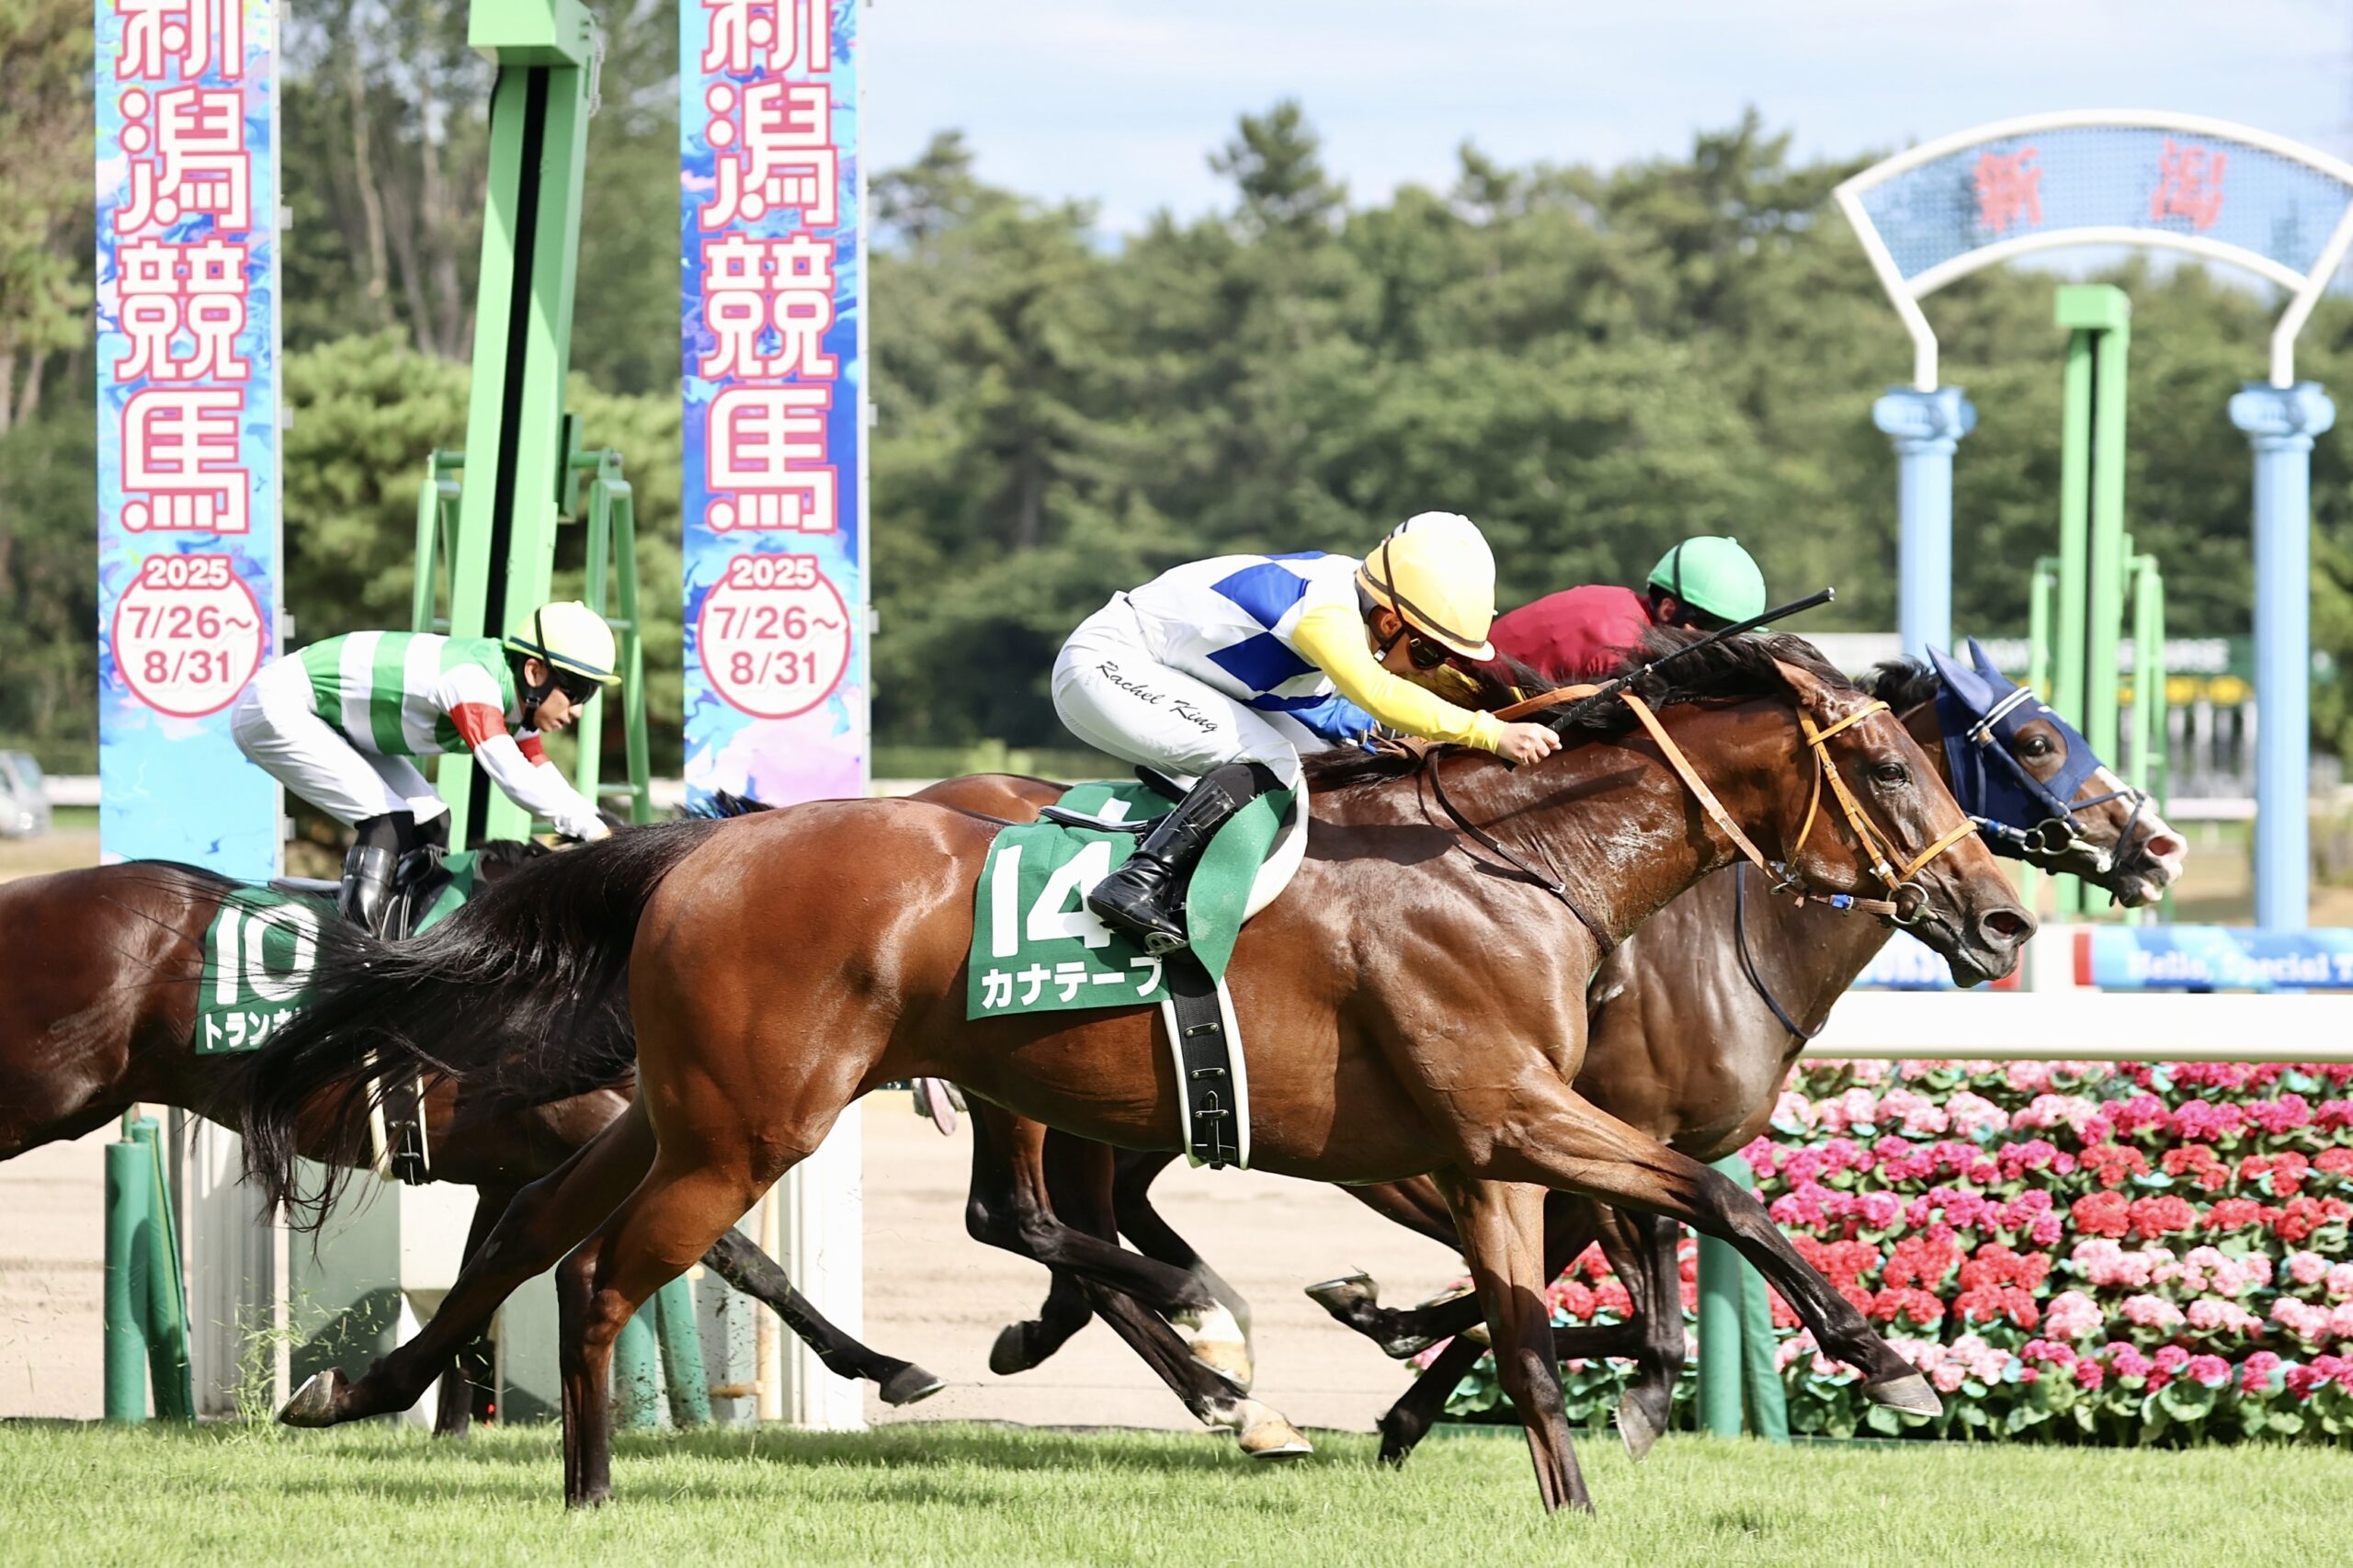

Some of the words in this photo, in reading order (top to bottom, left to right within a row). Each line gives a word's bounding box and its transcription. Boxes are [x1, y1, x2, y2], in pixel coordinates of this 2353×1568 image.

[144, 557, 230, 588] 2025
[730, 557, 816, 588] 2025
[143, 650, 229, 684] 8/31
[730, 651, 815, 685] 8/31
[1096, 661, 1165, 705] Rachel
[1169, 699, 1218, 733] King
[992, 840, 1112, 958] 14
[216, 903, 319, 1005] 10
[981, 954, 1163, 1010] カナテープ
